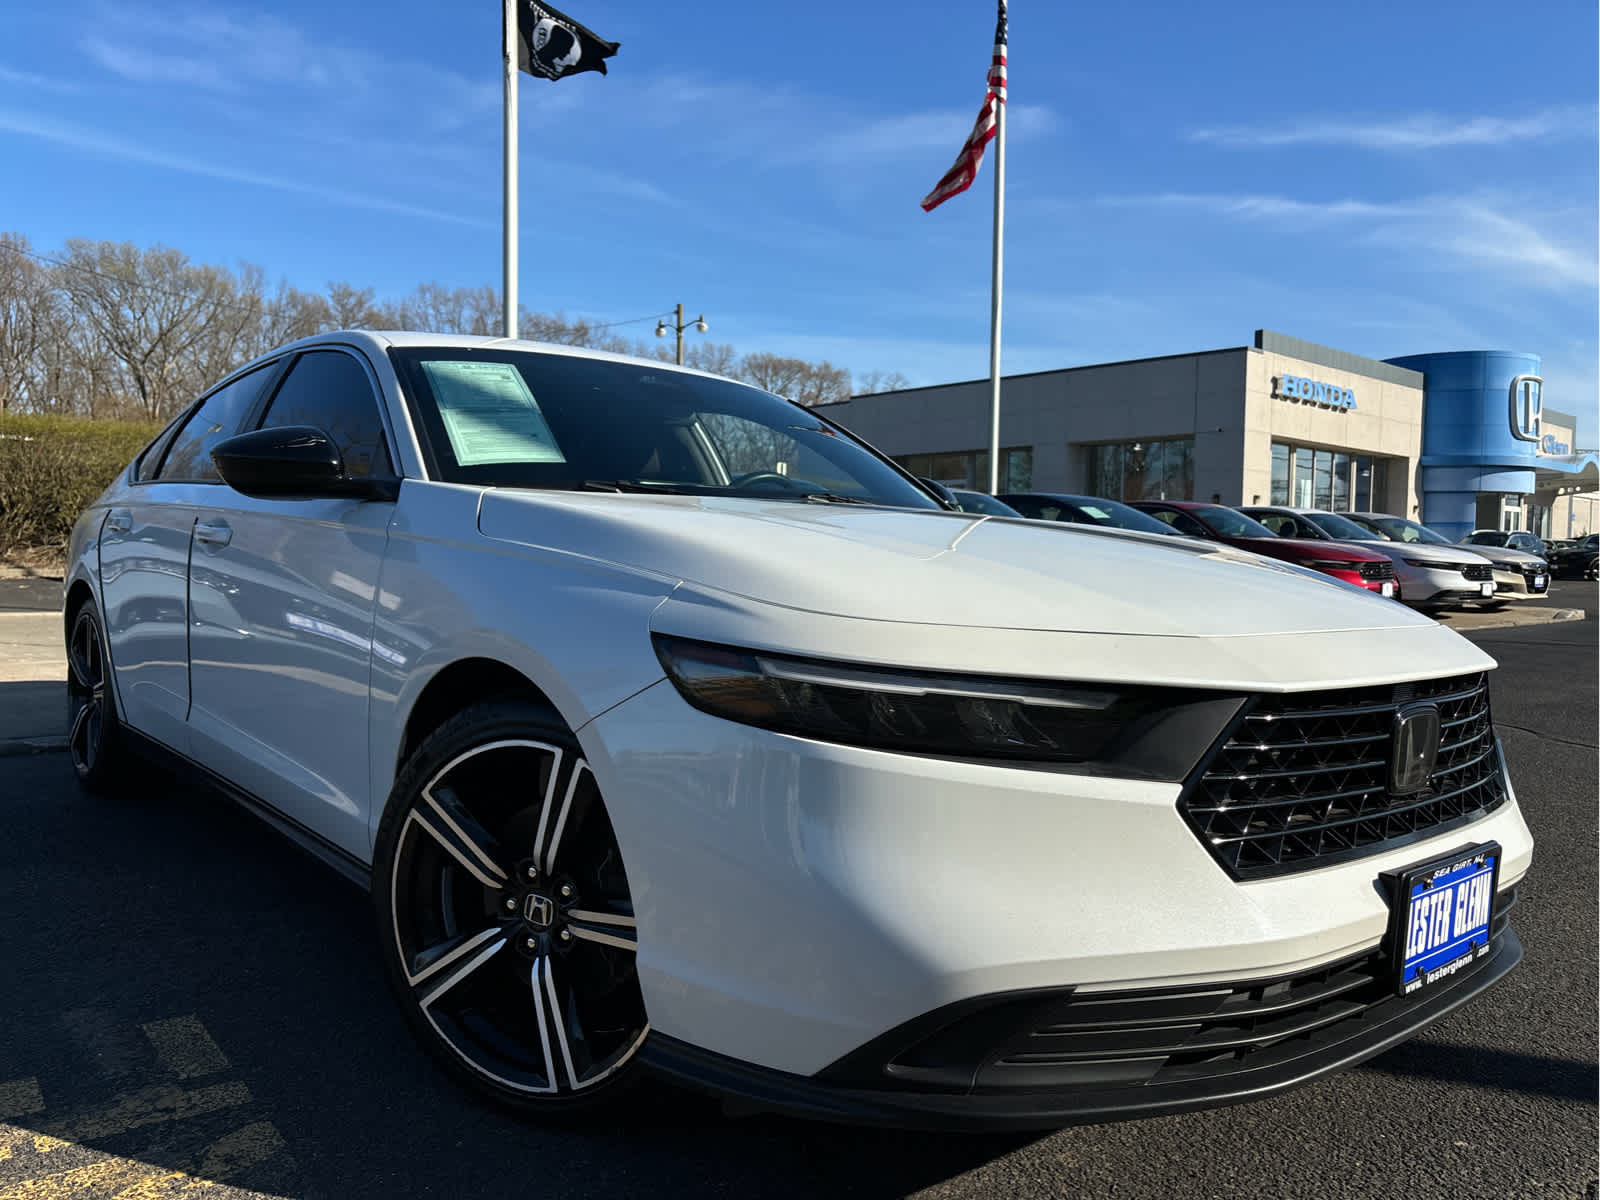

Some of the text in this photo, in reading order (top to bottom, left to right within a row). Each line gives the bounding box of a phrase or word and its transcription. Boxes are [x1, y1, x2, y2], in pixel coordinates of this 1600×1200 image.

[1282, 373, 1358, 410] HONDA
[1433, 866, 1451, 880] SEA
[1405, 871, 1492, 960] LESTER GLENN
[1427, 954, 1473, 985] lesterglenn
